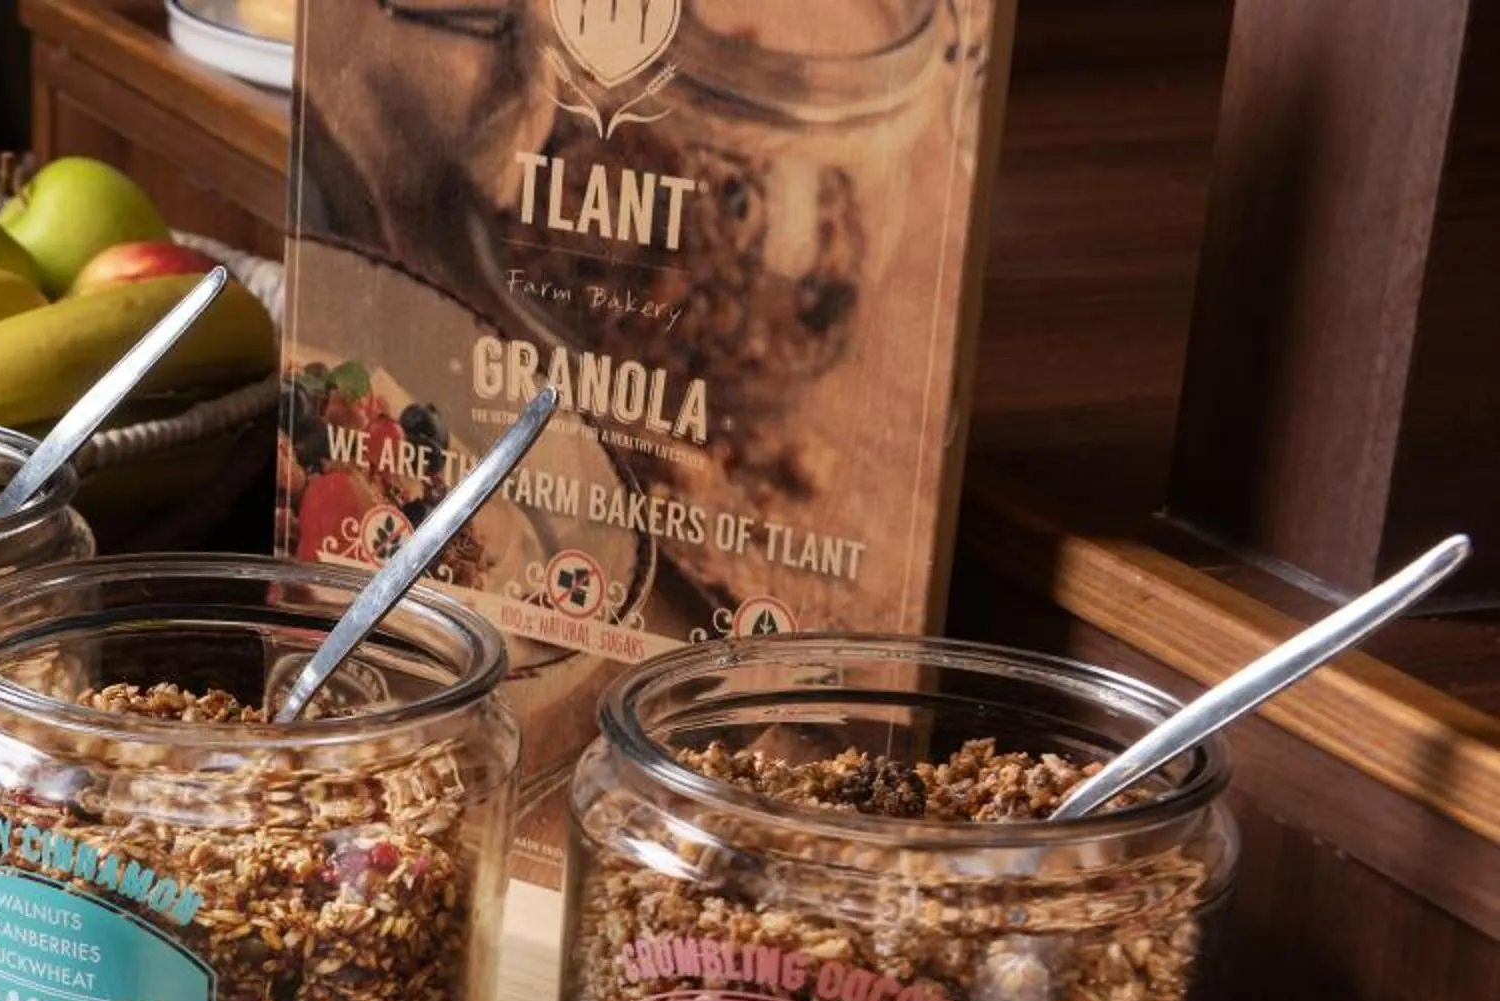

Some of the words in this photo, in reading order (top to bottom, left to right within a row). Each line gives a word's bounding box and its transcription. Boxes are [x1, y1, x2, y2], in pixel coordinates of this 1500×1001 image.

[515, 152, 695, 250] TLANT
[506, 268, 571, 301] Farm
[586, 284, 682, 331] Bakery
[473, 336, 707, 444] GRANOLA
[327, 424, 372, 467] WE
[379, 437, 433, 482] ARE
[441, 450, 479, 486] TH
[589, 486, 706, 544] BAKERS
[715, 514, 751, 551] OF
[764, 523, 867, 580] TLANT
[540, 615, 590, 645] NATURAL
[600, 630, 645, 659] SUGARS
[21, 822, 205, 927] CINNAMON
